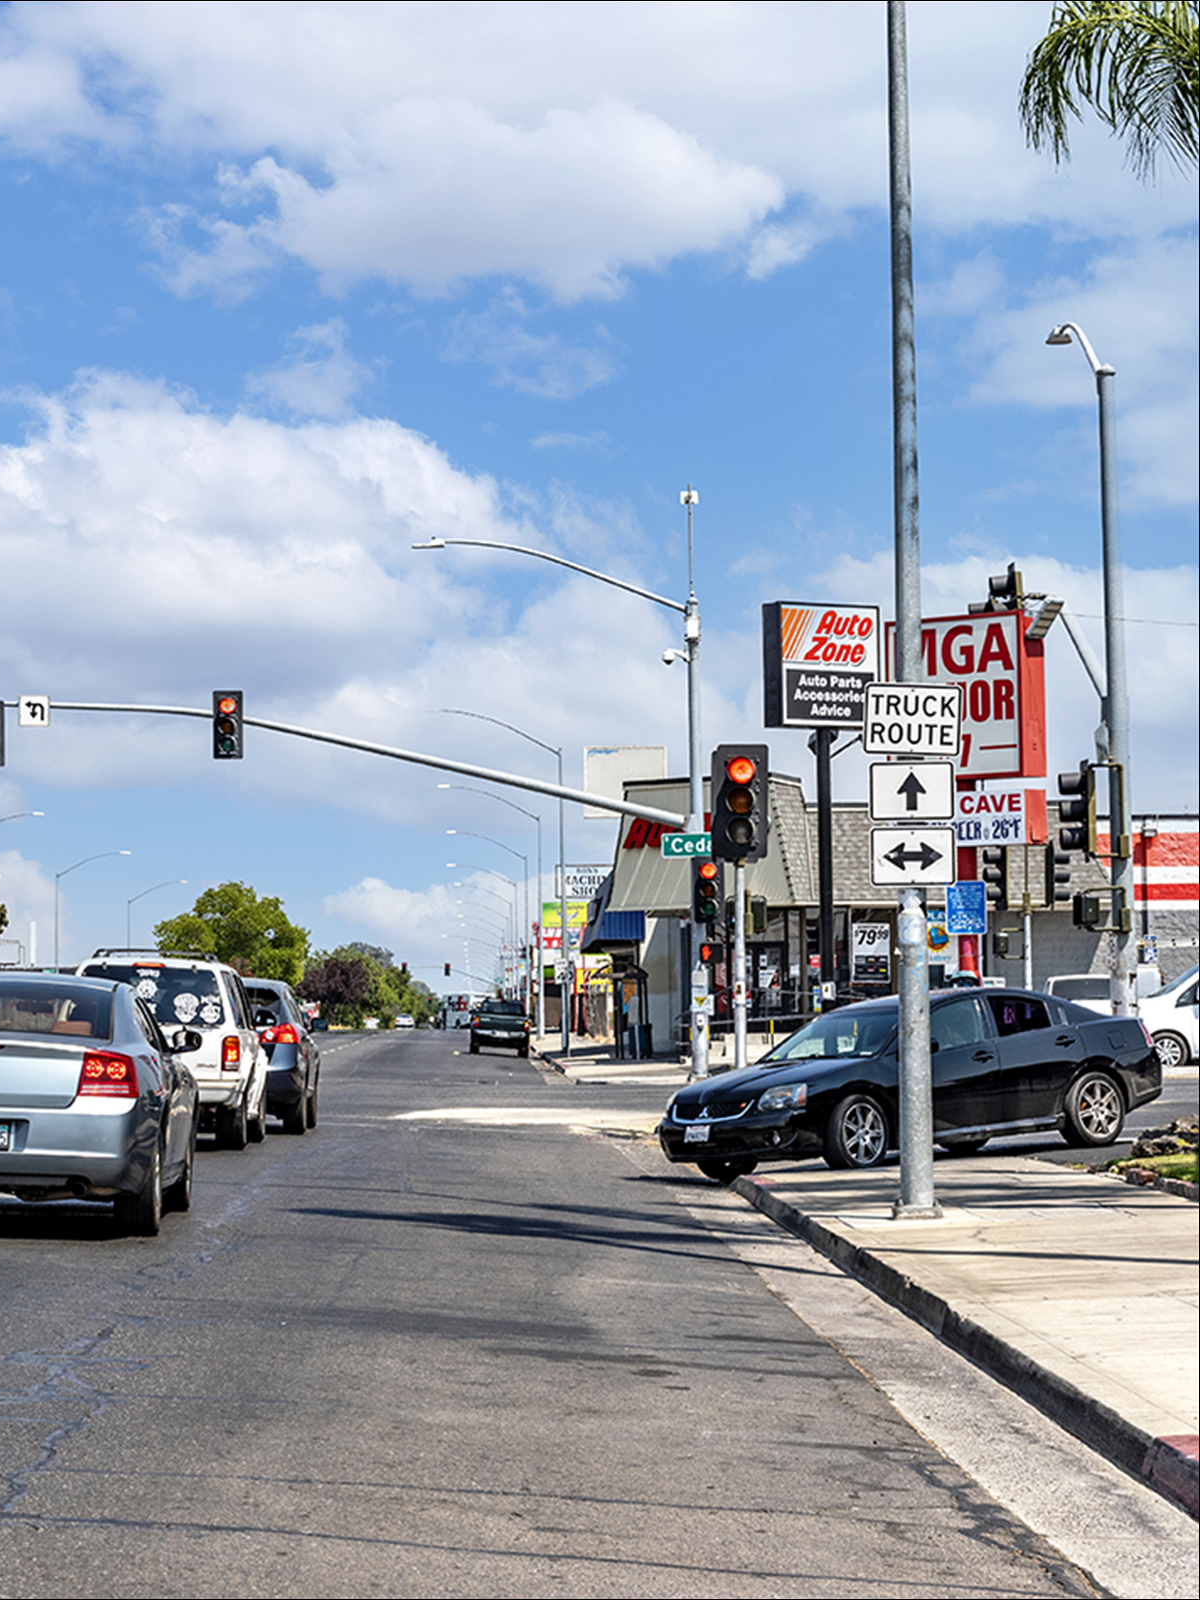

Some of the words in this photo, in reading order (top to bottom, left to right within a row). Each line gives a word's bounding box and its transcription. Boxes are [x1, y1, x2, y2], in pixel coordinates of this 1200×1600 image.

[815, 610, 873, 637] Auto
[803, 636, 865, 663] Zone
[798, 674, 827, 687] Auto
[830, 675, 862, 688] Parts
[810, 703, 852, 717] Advice
[871, 694, 956, 718] TRUCK
[961, 679, 1014, 723] OR
[870, 722, 954, 746] ROUTE
[960, 793, 1021, 814] CAVE
